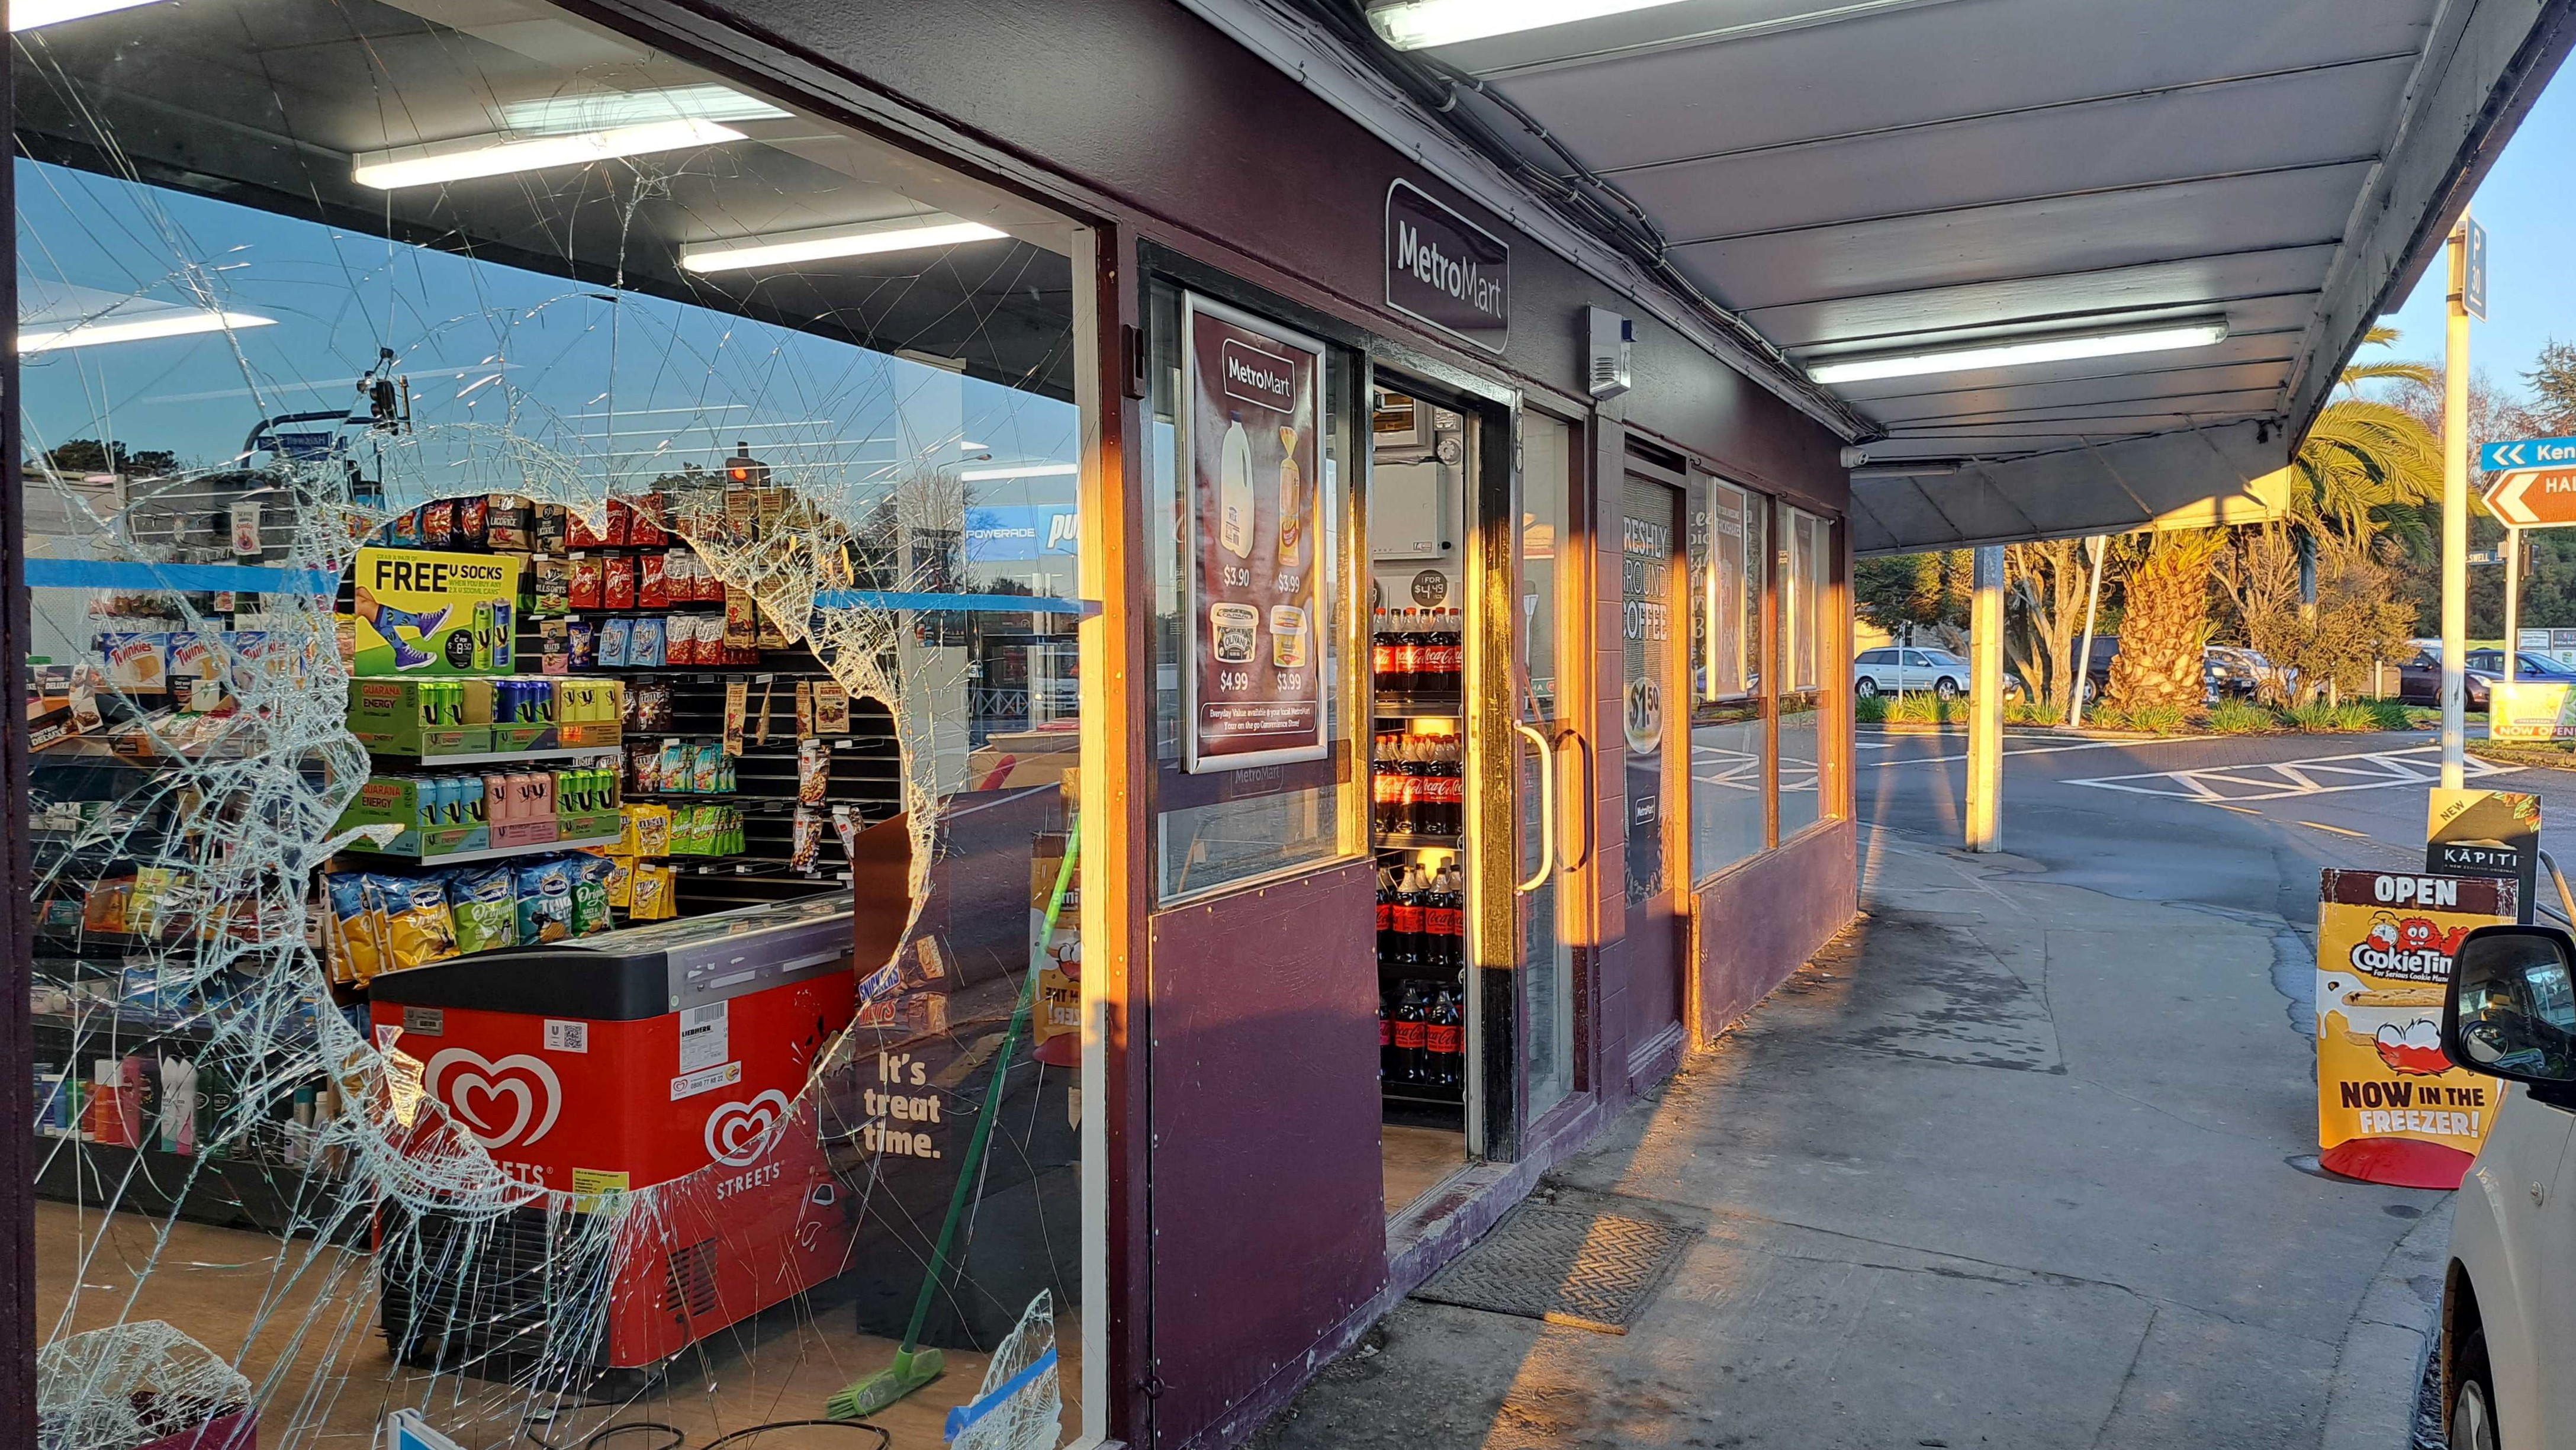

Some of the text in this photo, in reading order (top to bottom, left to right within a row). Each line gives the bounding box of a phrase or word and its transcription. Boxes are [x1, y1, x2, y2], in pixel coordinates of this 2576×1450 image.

[2473, 227, 2481, 261] P
[1398, 220, 1501, 319] MetroMart
[2471, 265, 2481, 294] 30
[1228, 356, 1290, 397] MetroMart
[2537, 445, 2576, 461] Ken
[491, 517, 517, 526] LICORICE
[1047, 514, 1078, 548] pu
[966, 528, 1035, 539] POWERADE
[1623, 516, 1667, 560] RESHLY
[2466, 553, 2490, 562] SWELL
[376, 560, 448, 593] FREE
[460, 565, 503, 580] SOCKS
[1224, 564, 1300, 593] $3.90 $3.99
[454, 634, 459, 642] 2
[362, 685, 401, 696] GUARANA
[1220, 670, 1301, 692] $4.99 $3.99
[364, 699, 397, 709] ENERGY
[1210, 709, 1231, 719] Everyday
[1232, 708, 1247, 717] Value
[1270, 709, 1280, 718] your
[1280, 708, 1291, 716] local
[1224, 722, 1237, 730] Your
[1253, 722, 1260, 731] go
[1260, 721, 1288, 729] Convenience
[2500, 726, 2533, 736] NOW
[32, 728, 67, 746] DELUXE
[1235, 766, 1281, 785] MetroMart
[362, 785, 401, 797] GUARANA
[362, 798, 393, 809] ENERGY
[2440, 800, 2465, 821] NEW
[2445, 848, 2517, 866] KĀPITI
[2375, 875, 2458, 906] OPEN
[2352, 944, 2453, 974] CookieTi
[2386, 970, 2408, 979] Serious
[2409, 973, 2431, 981] Cookie
[682, 1025, 712, 1037] LIEBHERR
[879, 1052, 926, 1085] It's
[864, 1088, 941, 1123] treat
[2340, 1082, 2485, 1108] NOW IN THE
[2359, 1110, 2479, 1138] FREEZER!
[864, 1122, 941, 1159] time.
[716, 1162, 780, 1200] STREETS
